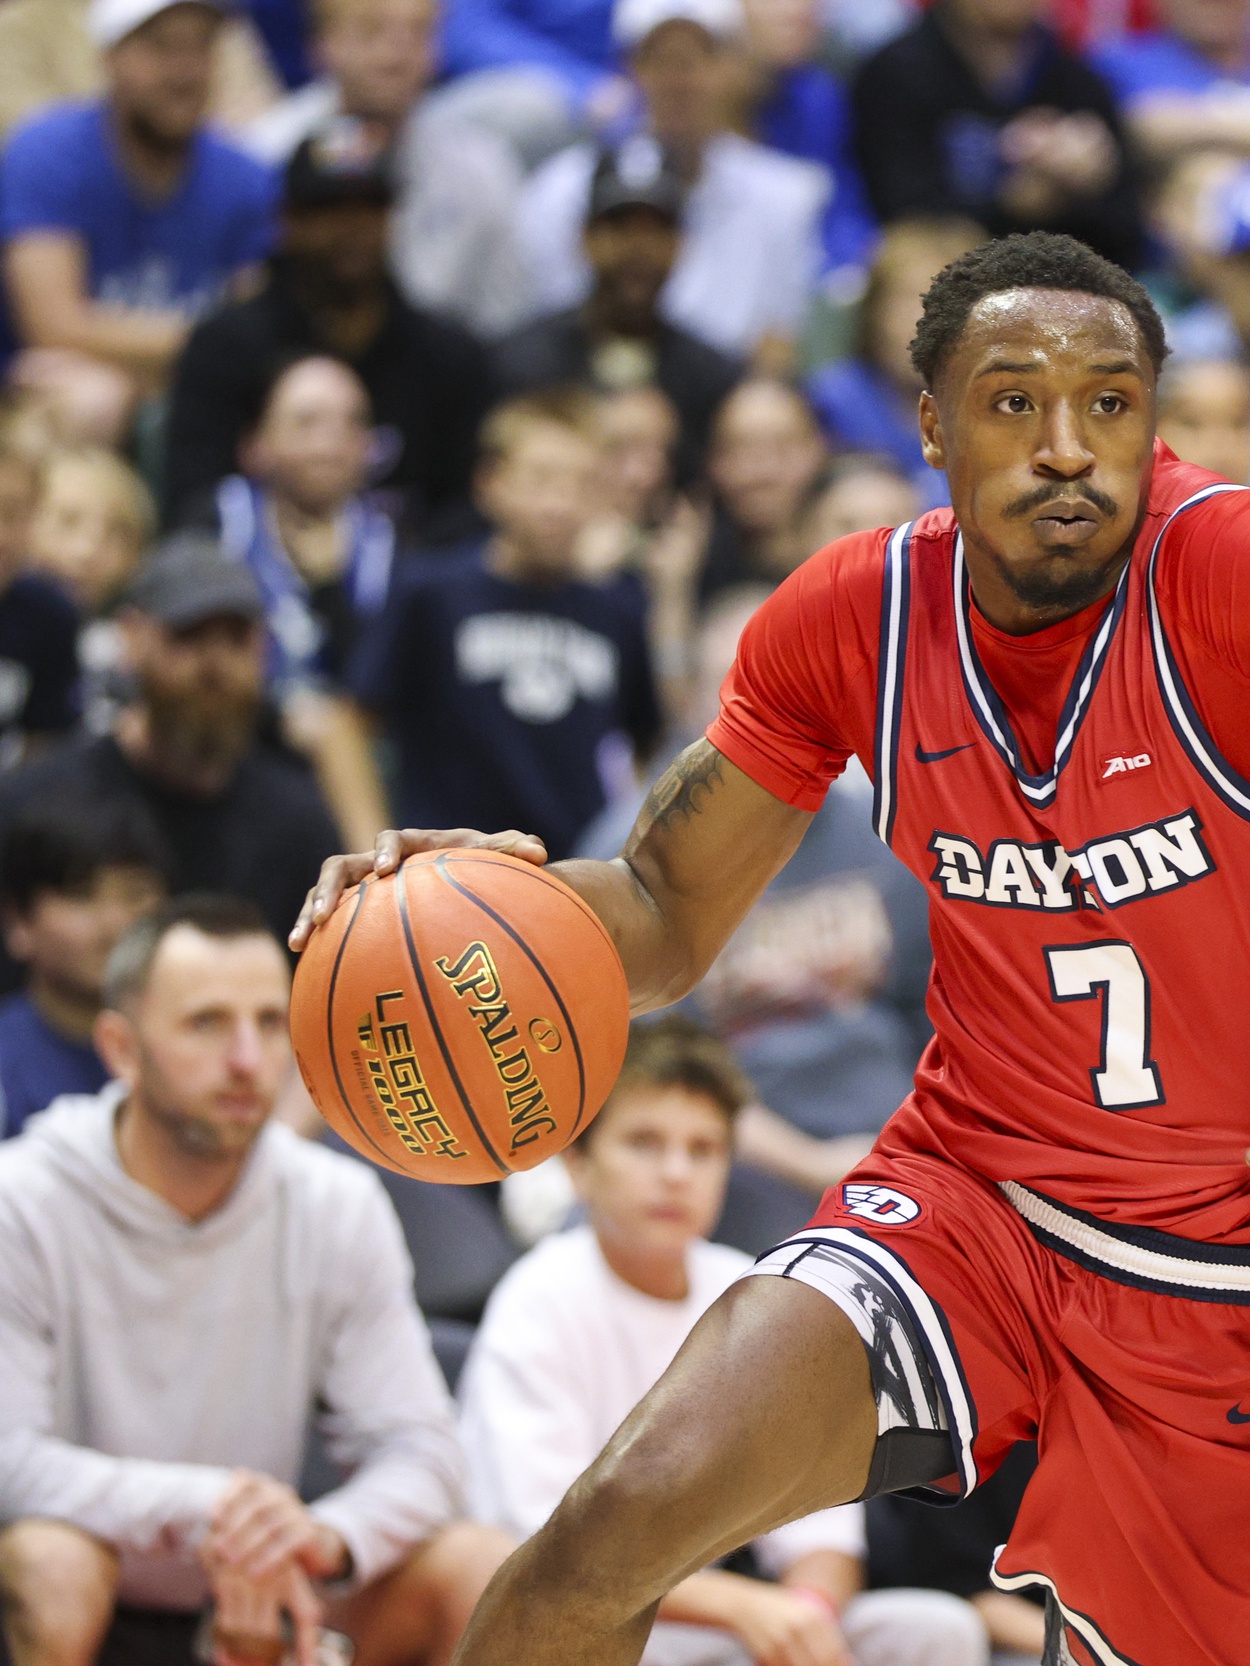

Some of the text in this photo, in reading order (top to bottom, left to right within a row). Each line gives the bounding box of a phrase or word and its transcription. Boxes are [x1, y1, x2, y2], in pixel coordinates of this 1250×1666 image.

[1102, 753, 1152, 778] A10
[351, 1050, 369, 1090] OFFICIAL
[375, 990, 470, 1160] LEGACY
[432, 940, 558, 1150] SPALDING
[1044, 941, 1163, 1109] 7
[366, 1057, 427, 1155] 1000
